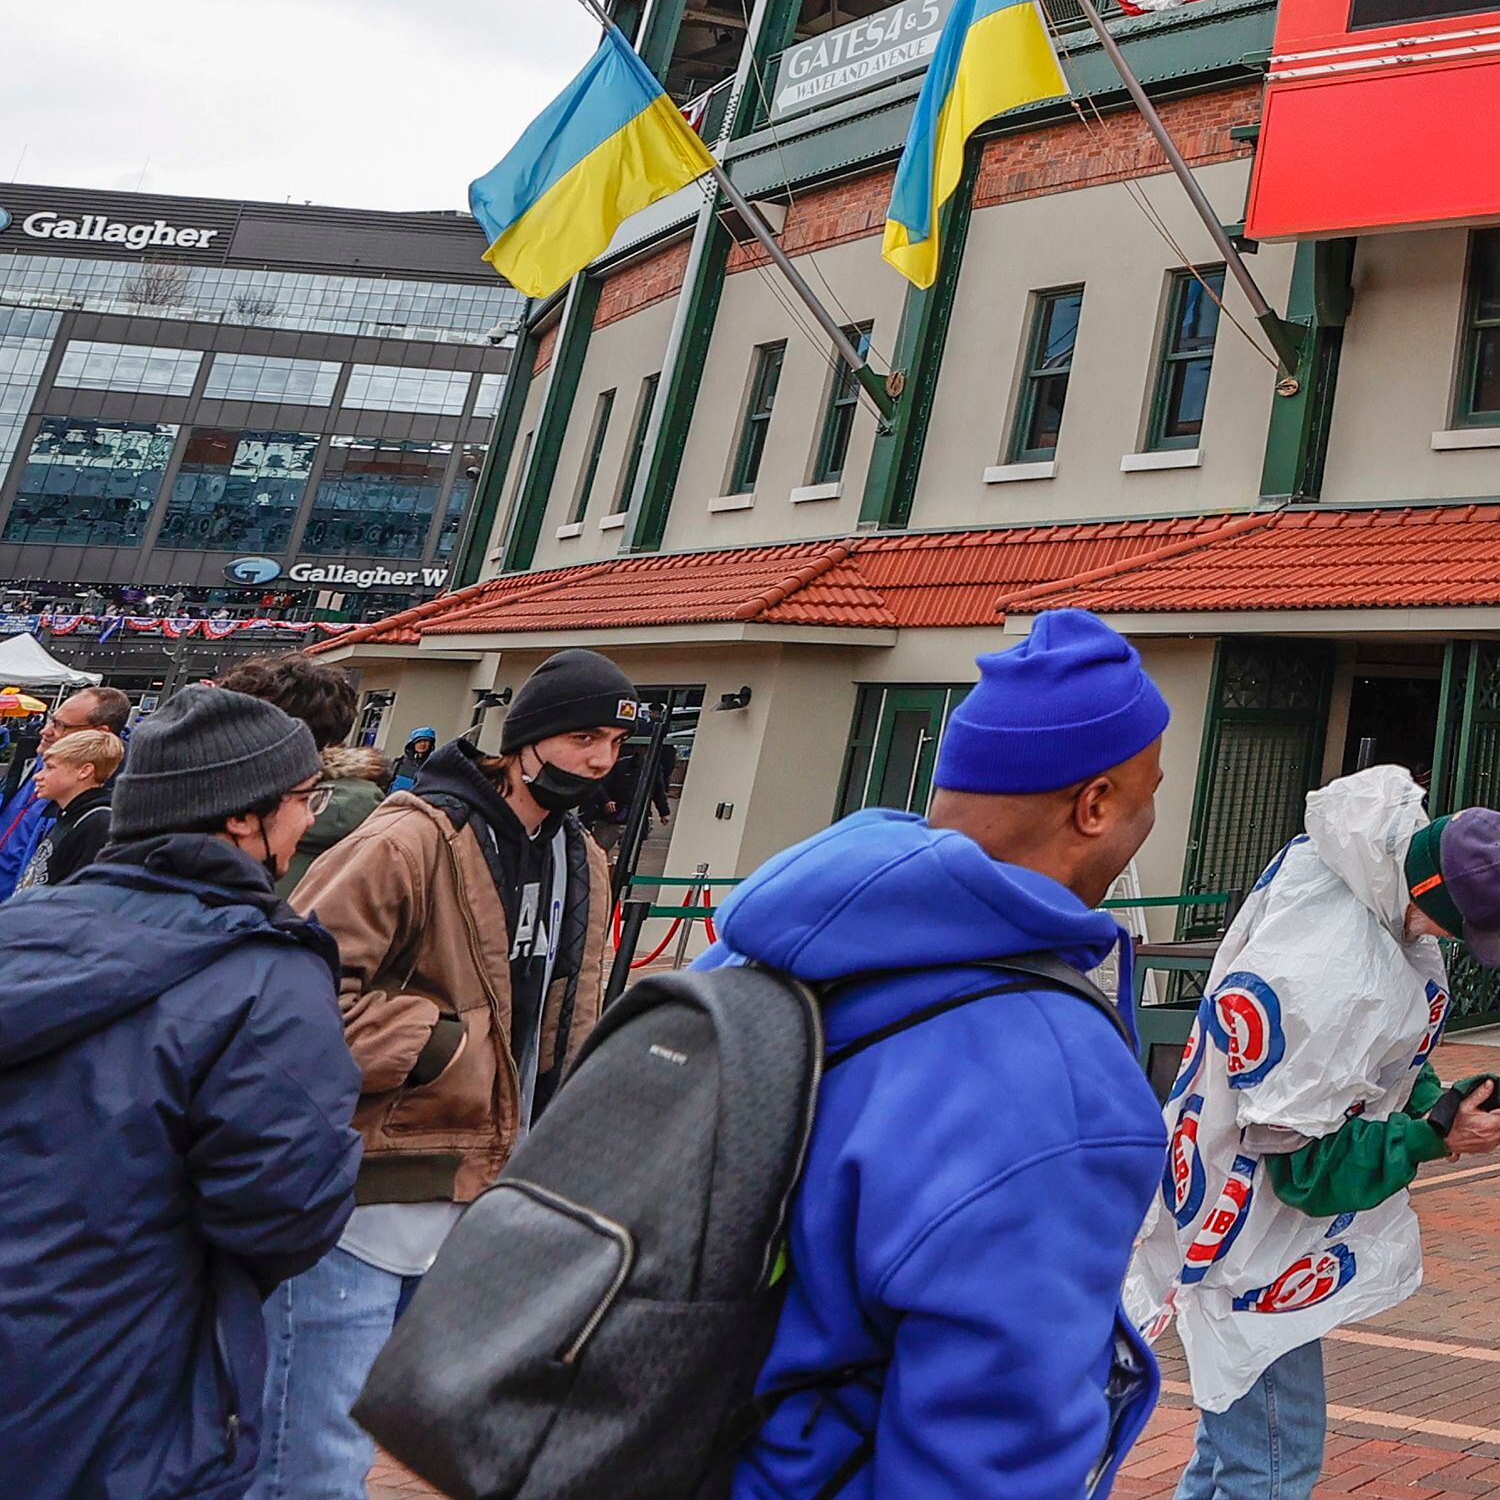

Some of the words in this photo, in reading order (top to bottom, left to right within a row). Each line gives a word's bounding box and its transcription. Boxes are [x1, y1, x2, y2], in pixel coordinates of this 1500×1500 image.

[788, 16, 885, 79] GATES
[884, 7, 904, 41] 4
[904, 12, 917, 30] &
[797, 60, 870, 100] WAVELAND
[873, 38, 929, 69] AVENUE
[22, 211, 219, 251] Gallagher
[289, 563, 417, 587] Gallagher
